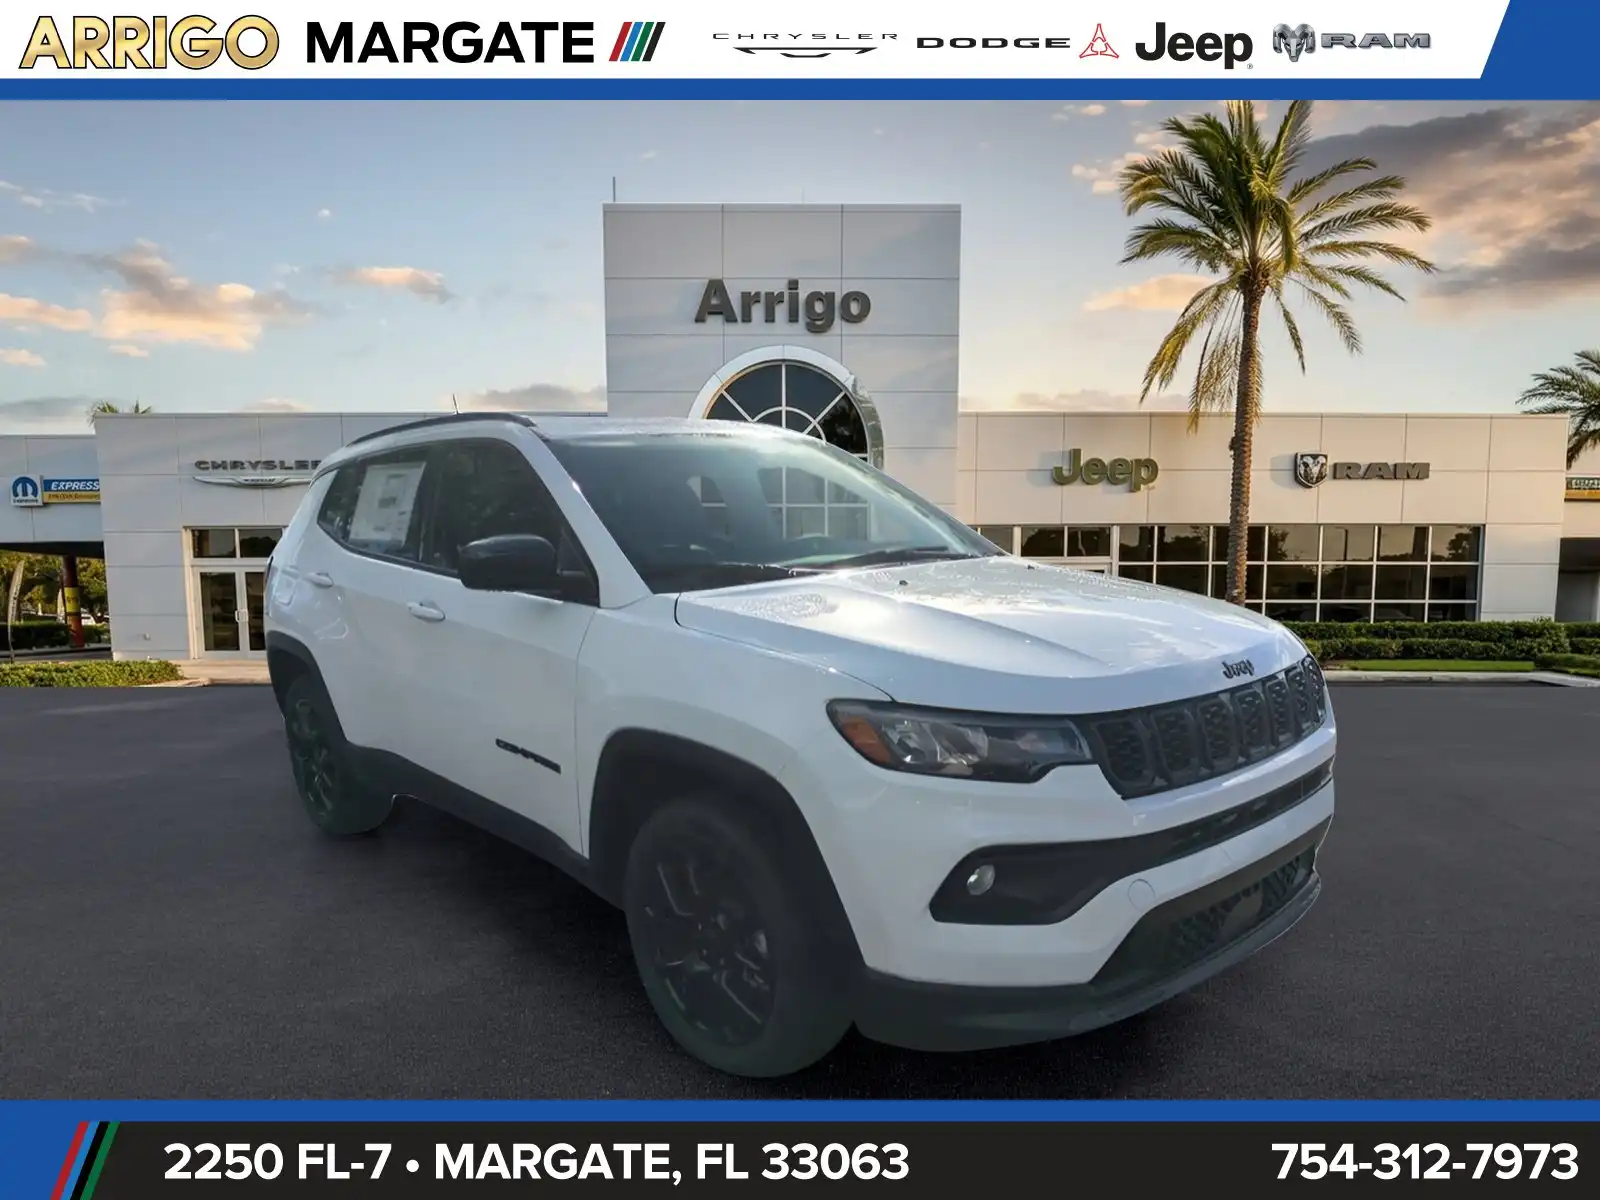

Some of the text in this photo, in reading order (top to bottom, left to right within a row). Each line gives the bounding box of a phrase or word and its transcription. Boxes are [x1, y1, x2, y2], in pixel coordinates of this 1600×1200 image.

[694, 279, 872, 333] Arrigo
[51, 481, 99, 491] EXPRESS
[1052, 448, 1158, 493] Jeep
[1333, 462, 1430, 480] RAM
